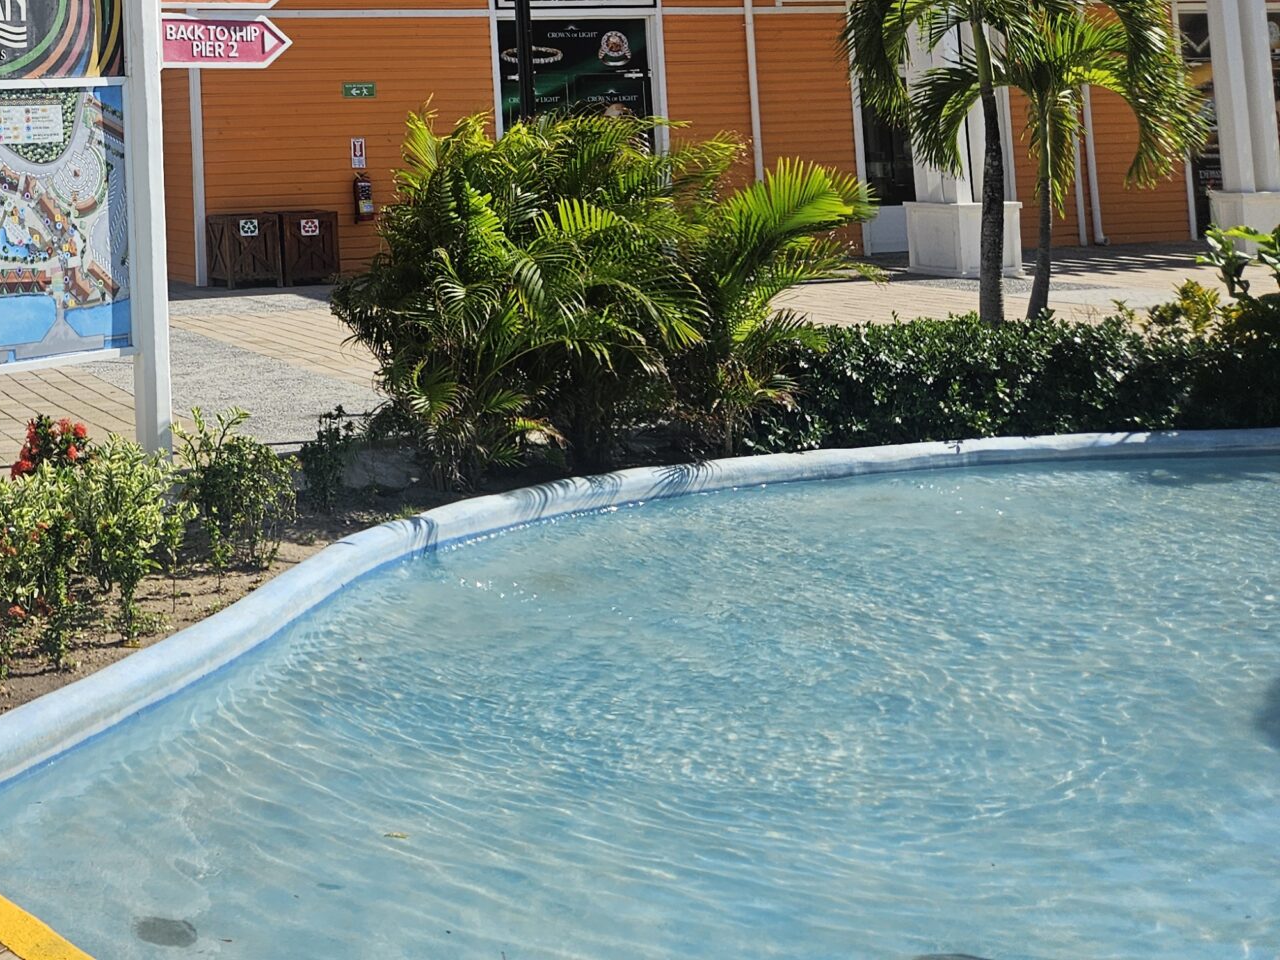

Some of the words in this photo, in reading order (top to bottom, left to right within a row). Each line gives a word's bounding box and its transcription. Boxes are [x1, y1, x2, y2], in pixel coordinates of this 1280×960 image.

[166, 25, 205, 40] BACK
[207, 25, 228, 40] TO
[230, 26, 260, 42] SHIP
[192, 41, 224, 57] PIER
[228, 42, 239, 57] 2
